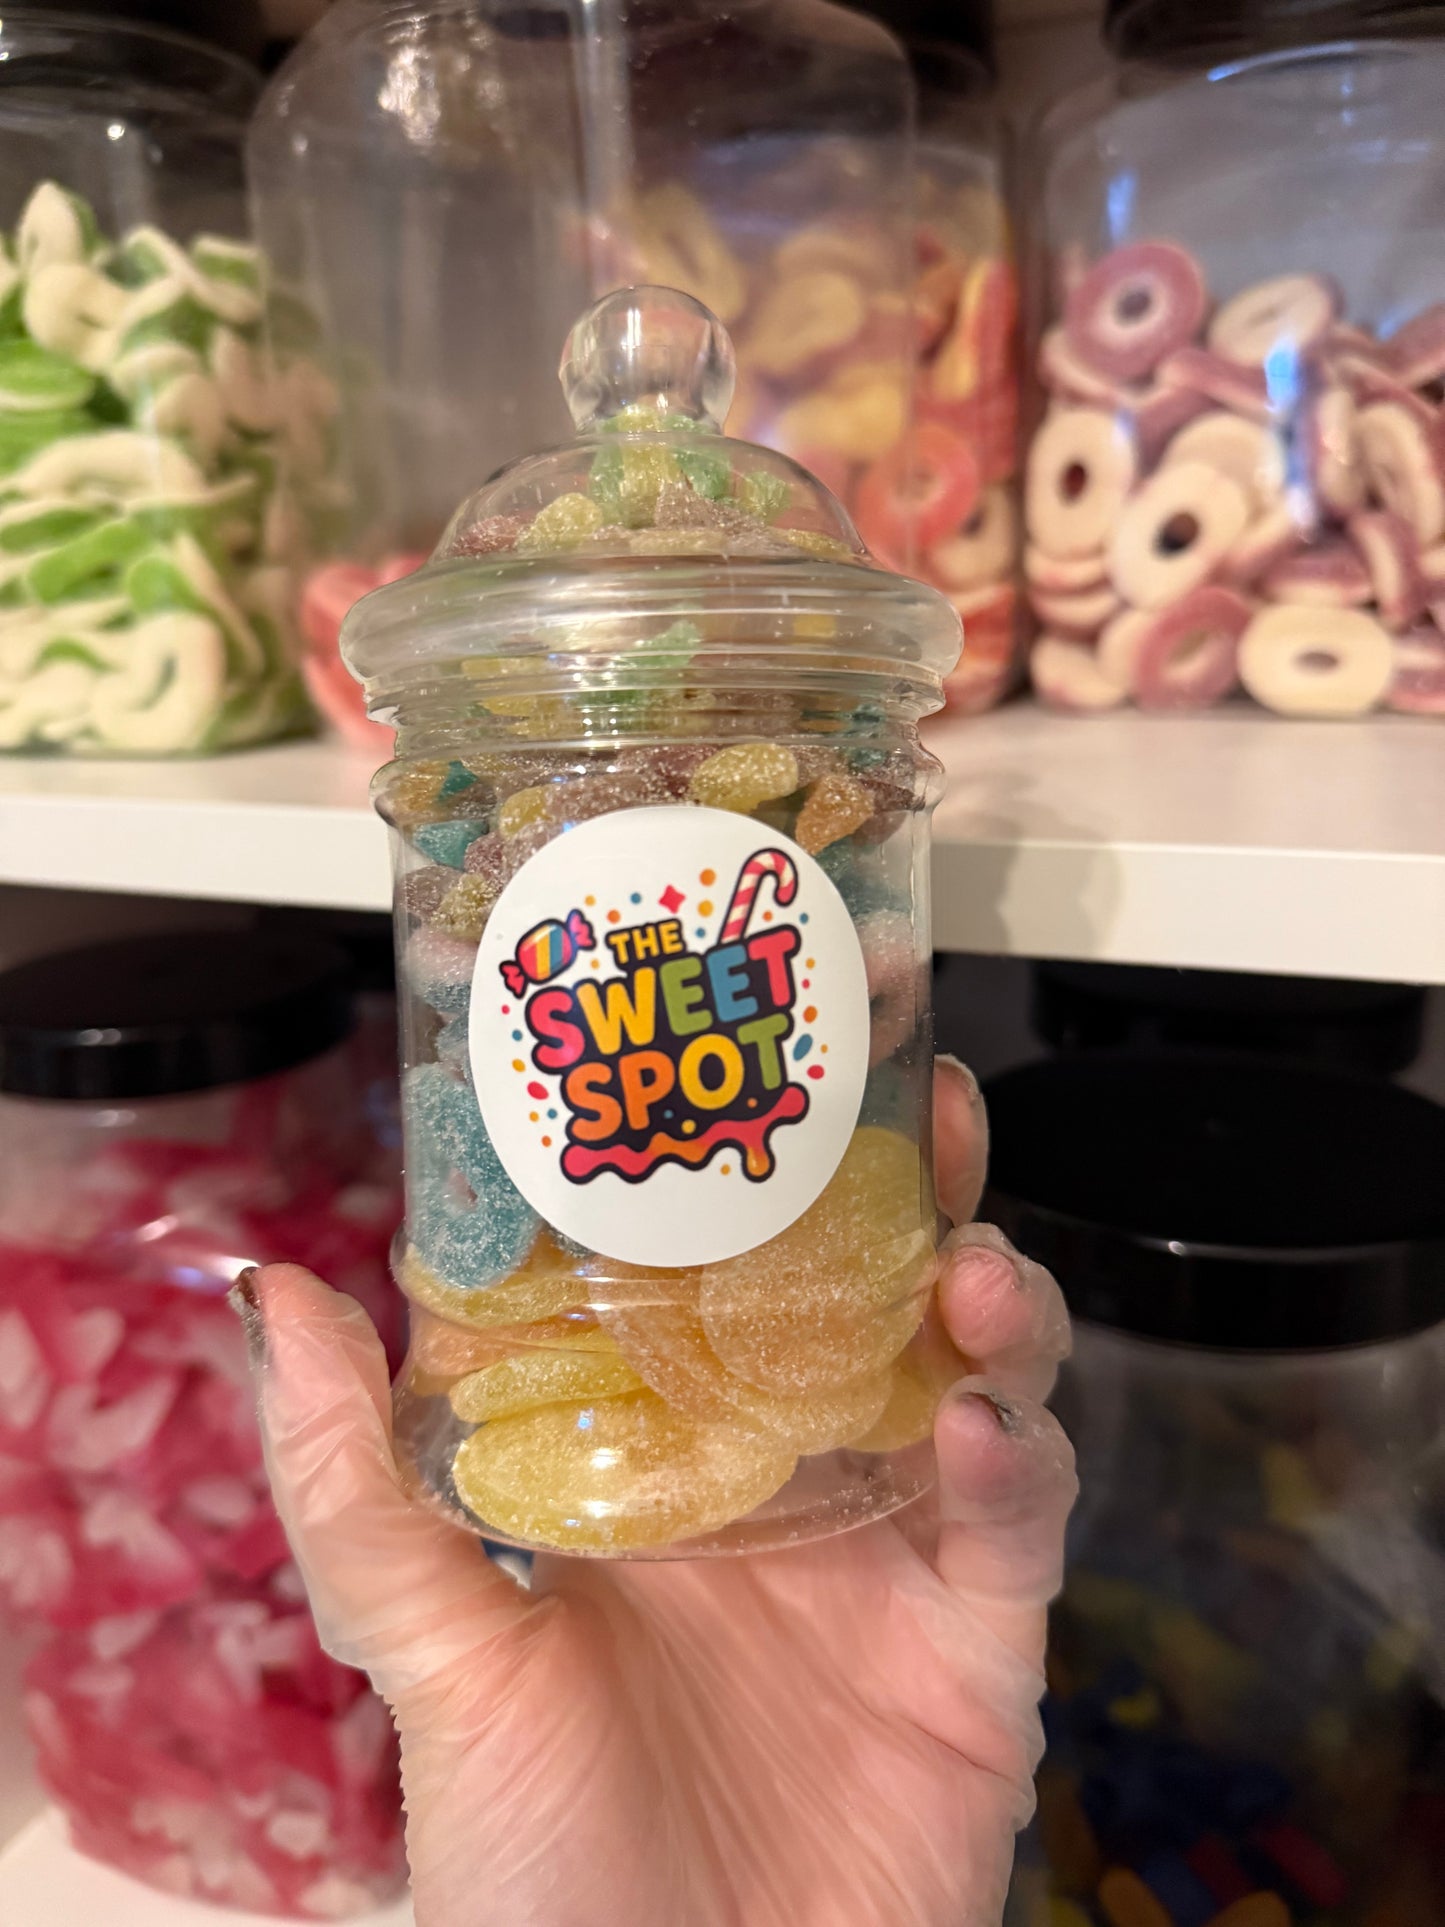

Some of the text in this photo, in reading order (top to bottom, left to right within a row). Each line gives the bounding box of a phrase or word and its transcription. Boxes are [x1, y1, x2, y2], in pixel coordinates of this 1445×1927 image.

[529, 929, 797, 1069] SWEET
[609, 923, 683, 964] THE
[566, 1013, 788, 1142] SPOT
